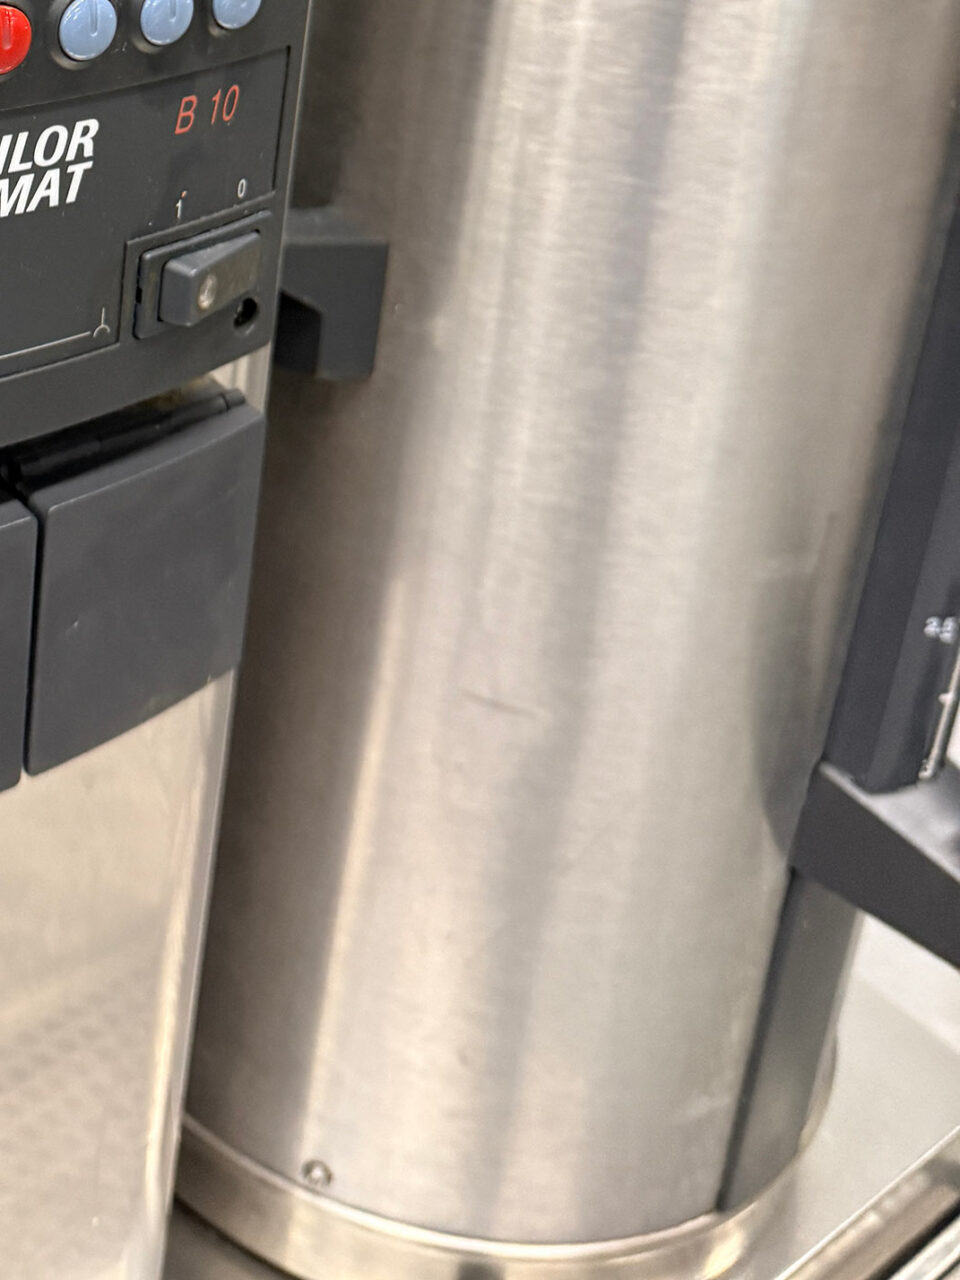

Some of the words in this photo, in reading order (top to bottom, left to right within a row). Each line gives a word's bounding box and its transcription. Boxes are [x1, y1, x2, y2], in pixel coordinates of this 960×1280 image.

[175, 95, 198, 135] B
[211, 84, 240, 125] 10
[237, 178, 246, 199] 0
